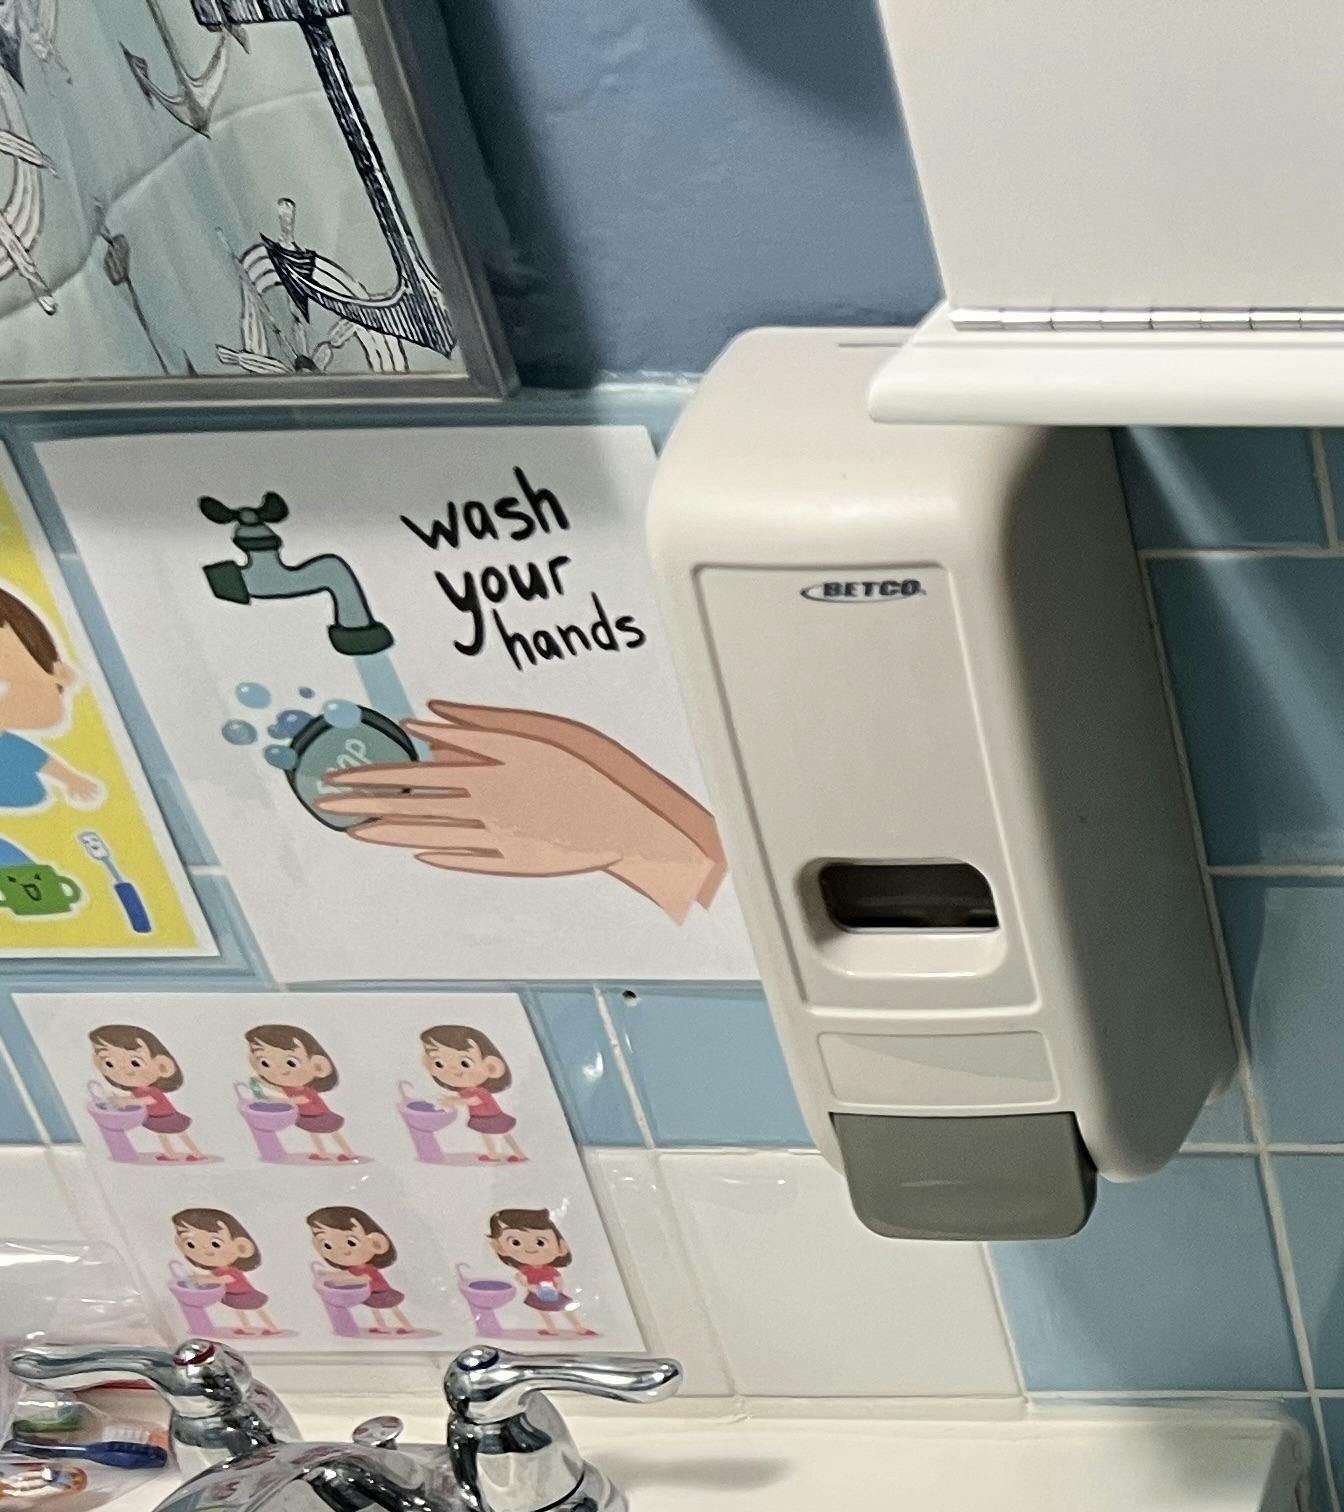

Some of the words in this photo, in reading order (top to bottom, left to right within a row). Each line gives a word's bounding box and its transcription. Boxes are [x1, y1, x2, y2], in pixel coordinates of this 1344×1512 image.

[399, 466, 570, 551] wash
[435, 555, 571, 656] your
[823, 579, 921, 597] BETCO
[492, 591, 647, 671] hands
